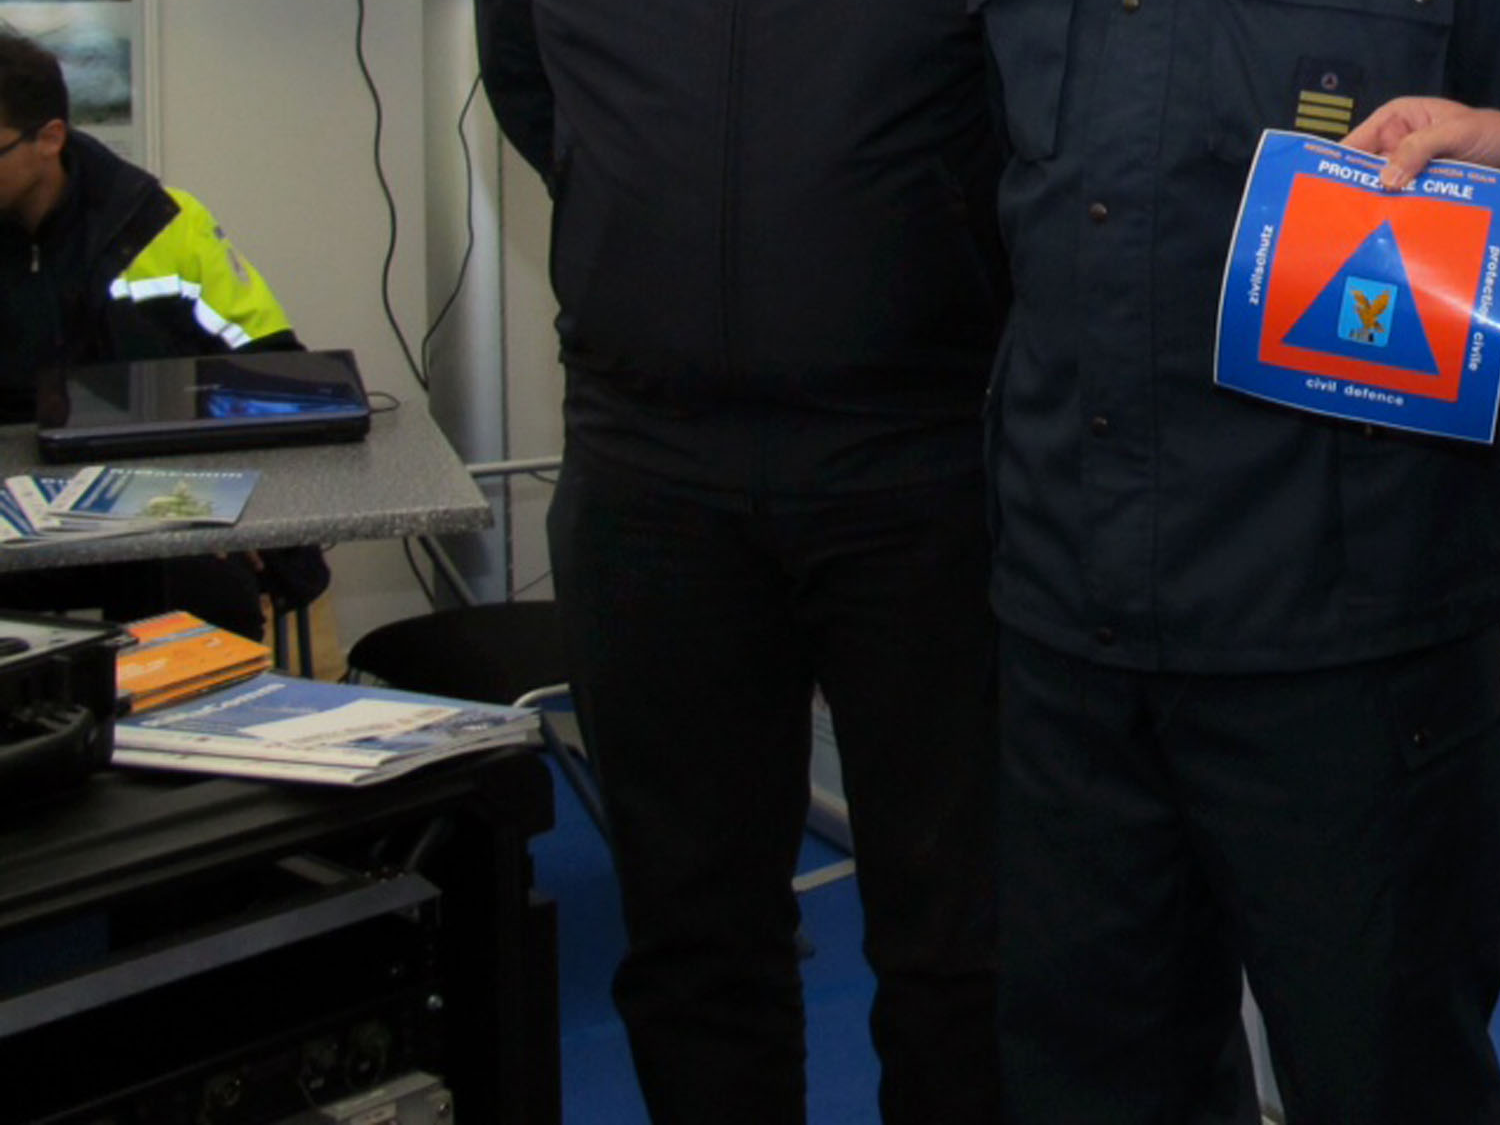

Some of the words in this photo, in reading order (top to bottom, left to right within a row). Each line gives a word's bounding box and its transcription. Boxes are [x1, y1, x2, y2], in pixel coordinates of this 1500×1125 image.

[1422, 178, 1474, 199] CIVILE
[1305, 376, 1338, 393] civil
[1343, 383, 1404, 407] defence
